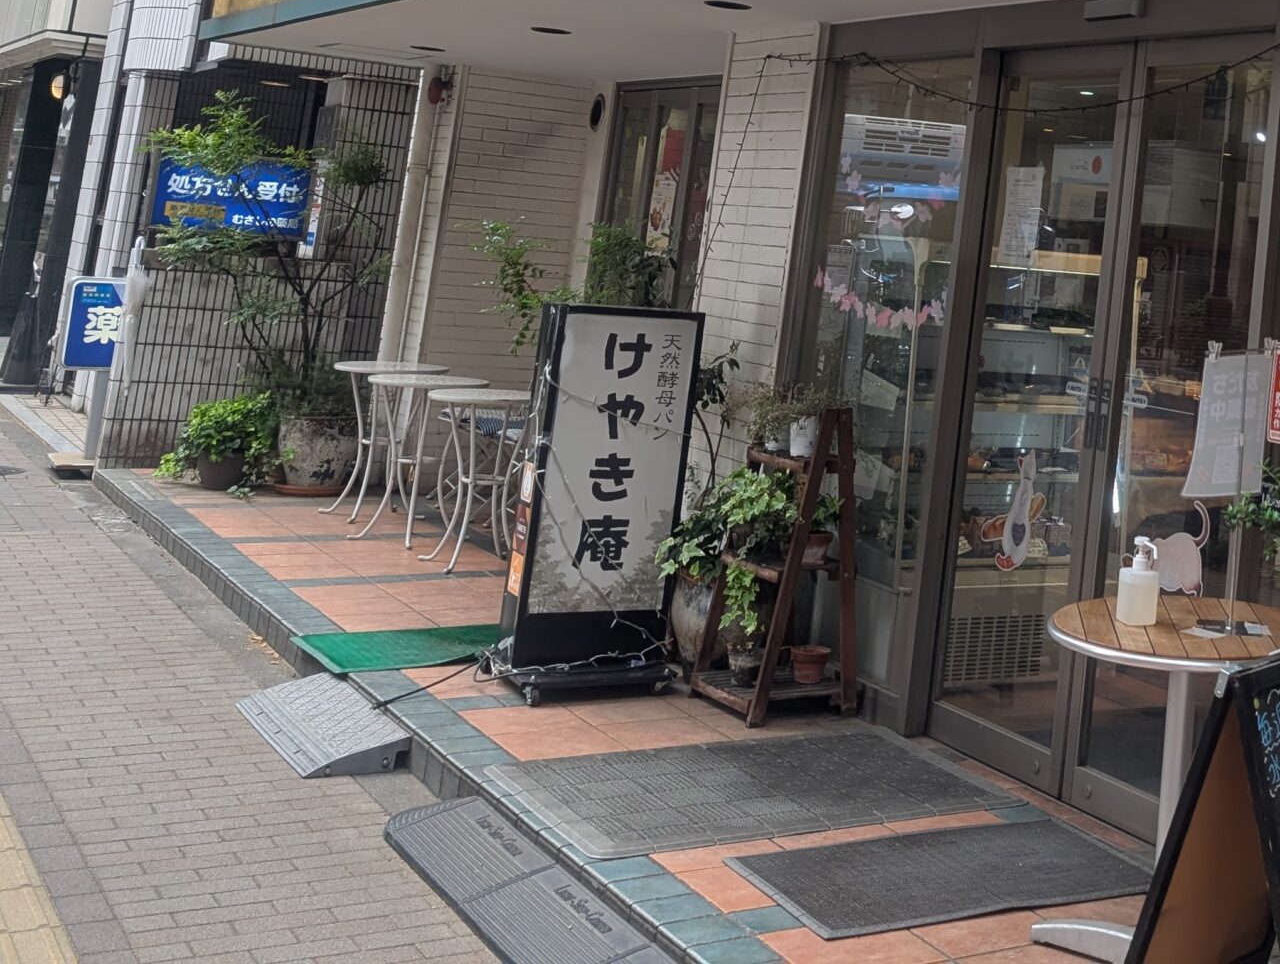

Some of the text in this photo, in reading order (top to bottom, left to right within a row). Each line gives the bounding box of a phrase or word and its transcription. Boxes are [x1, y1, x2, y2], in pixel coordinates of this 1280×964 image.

[572, 332, 653, 572] けやき庵
[652, 333, 682, 442] 天然酵母パン
